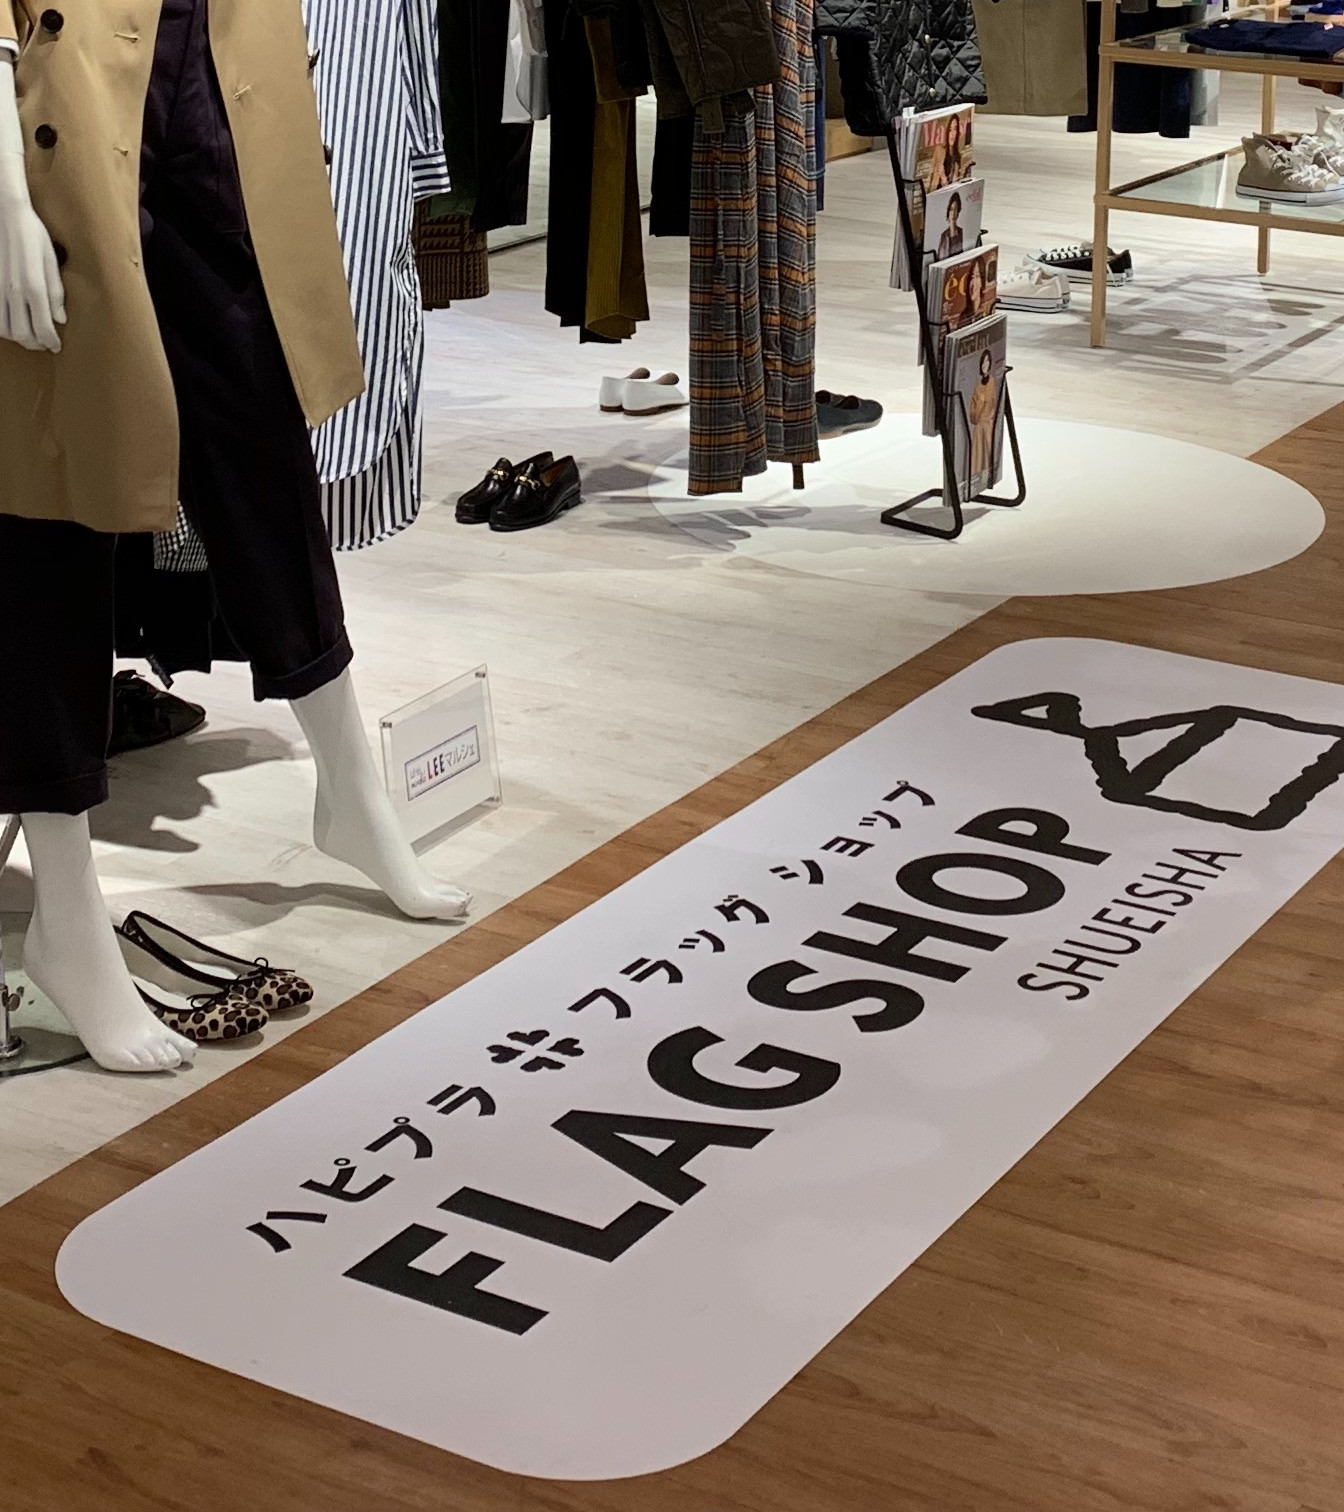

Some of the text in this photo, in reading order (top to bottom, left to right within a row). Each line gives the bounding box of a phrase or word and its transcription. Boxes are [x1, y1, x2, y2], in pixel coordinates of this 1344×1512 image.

[341, 806, 1112, 1336] FLAG SHOP
[1016, 847, 1244, 1002] SHUEISHA
